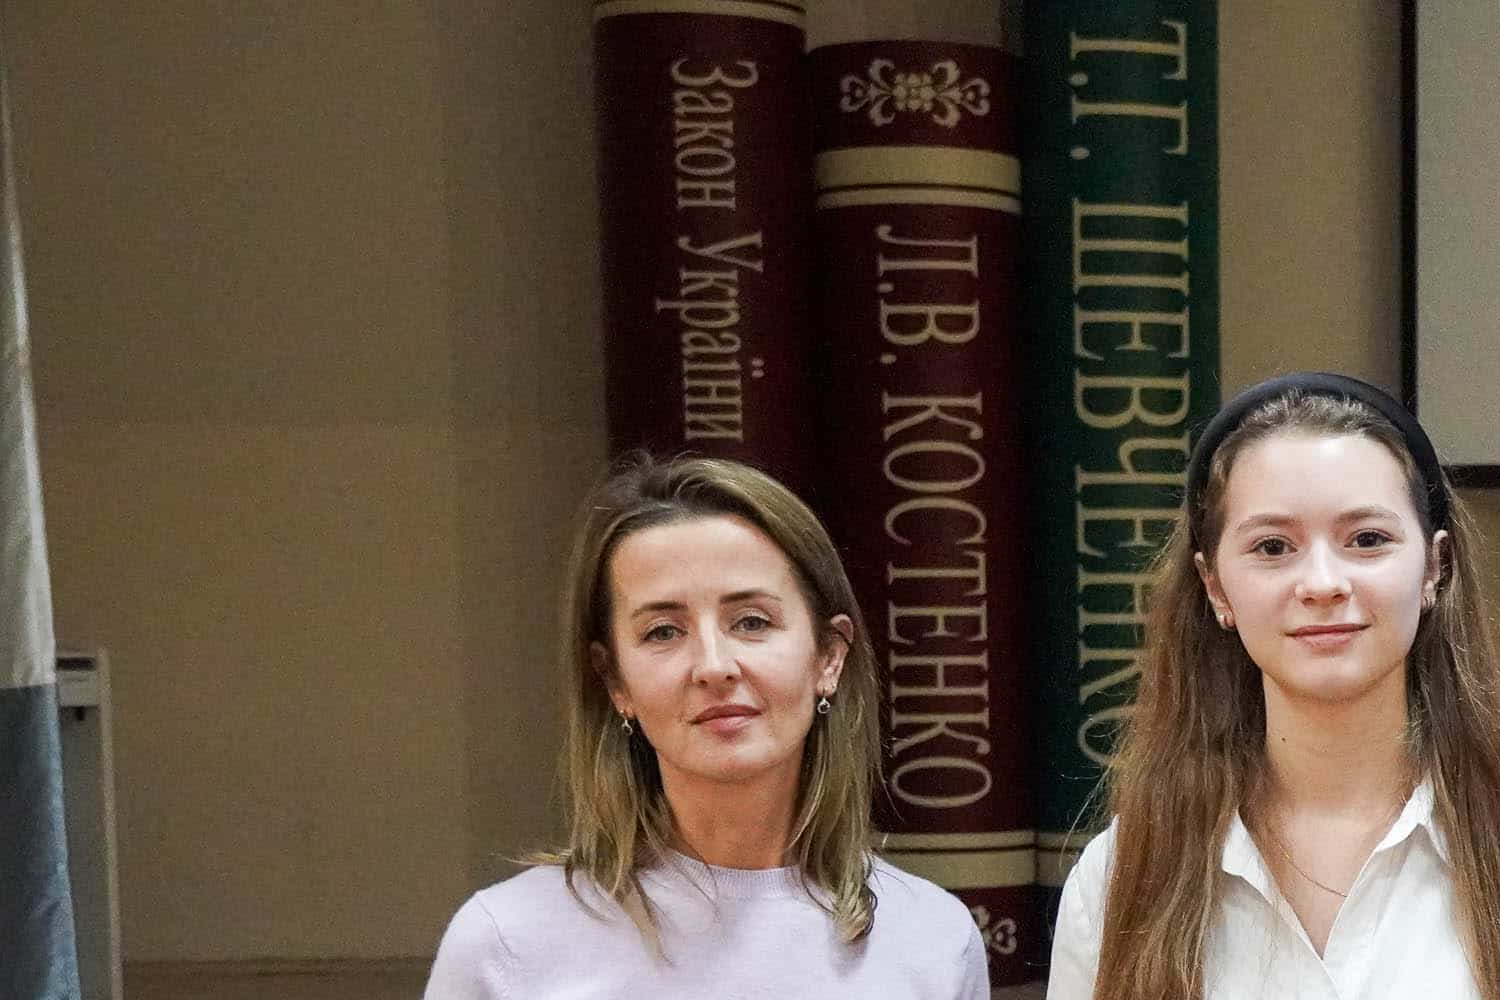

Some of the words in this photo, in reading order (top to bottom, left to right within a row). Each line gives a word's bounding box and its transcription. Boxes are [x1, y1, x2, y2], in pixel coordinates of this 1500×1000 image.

[671, 58, 760, 211] Закон
[1067, 20, 1189, 161] Т.Г.
[655, 231, 765, 443] України
[876, 224, 981, 366] Л.В.
[881, 391, 992, 808] КОСТЕНКО
